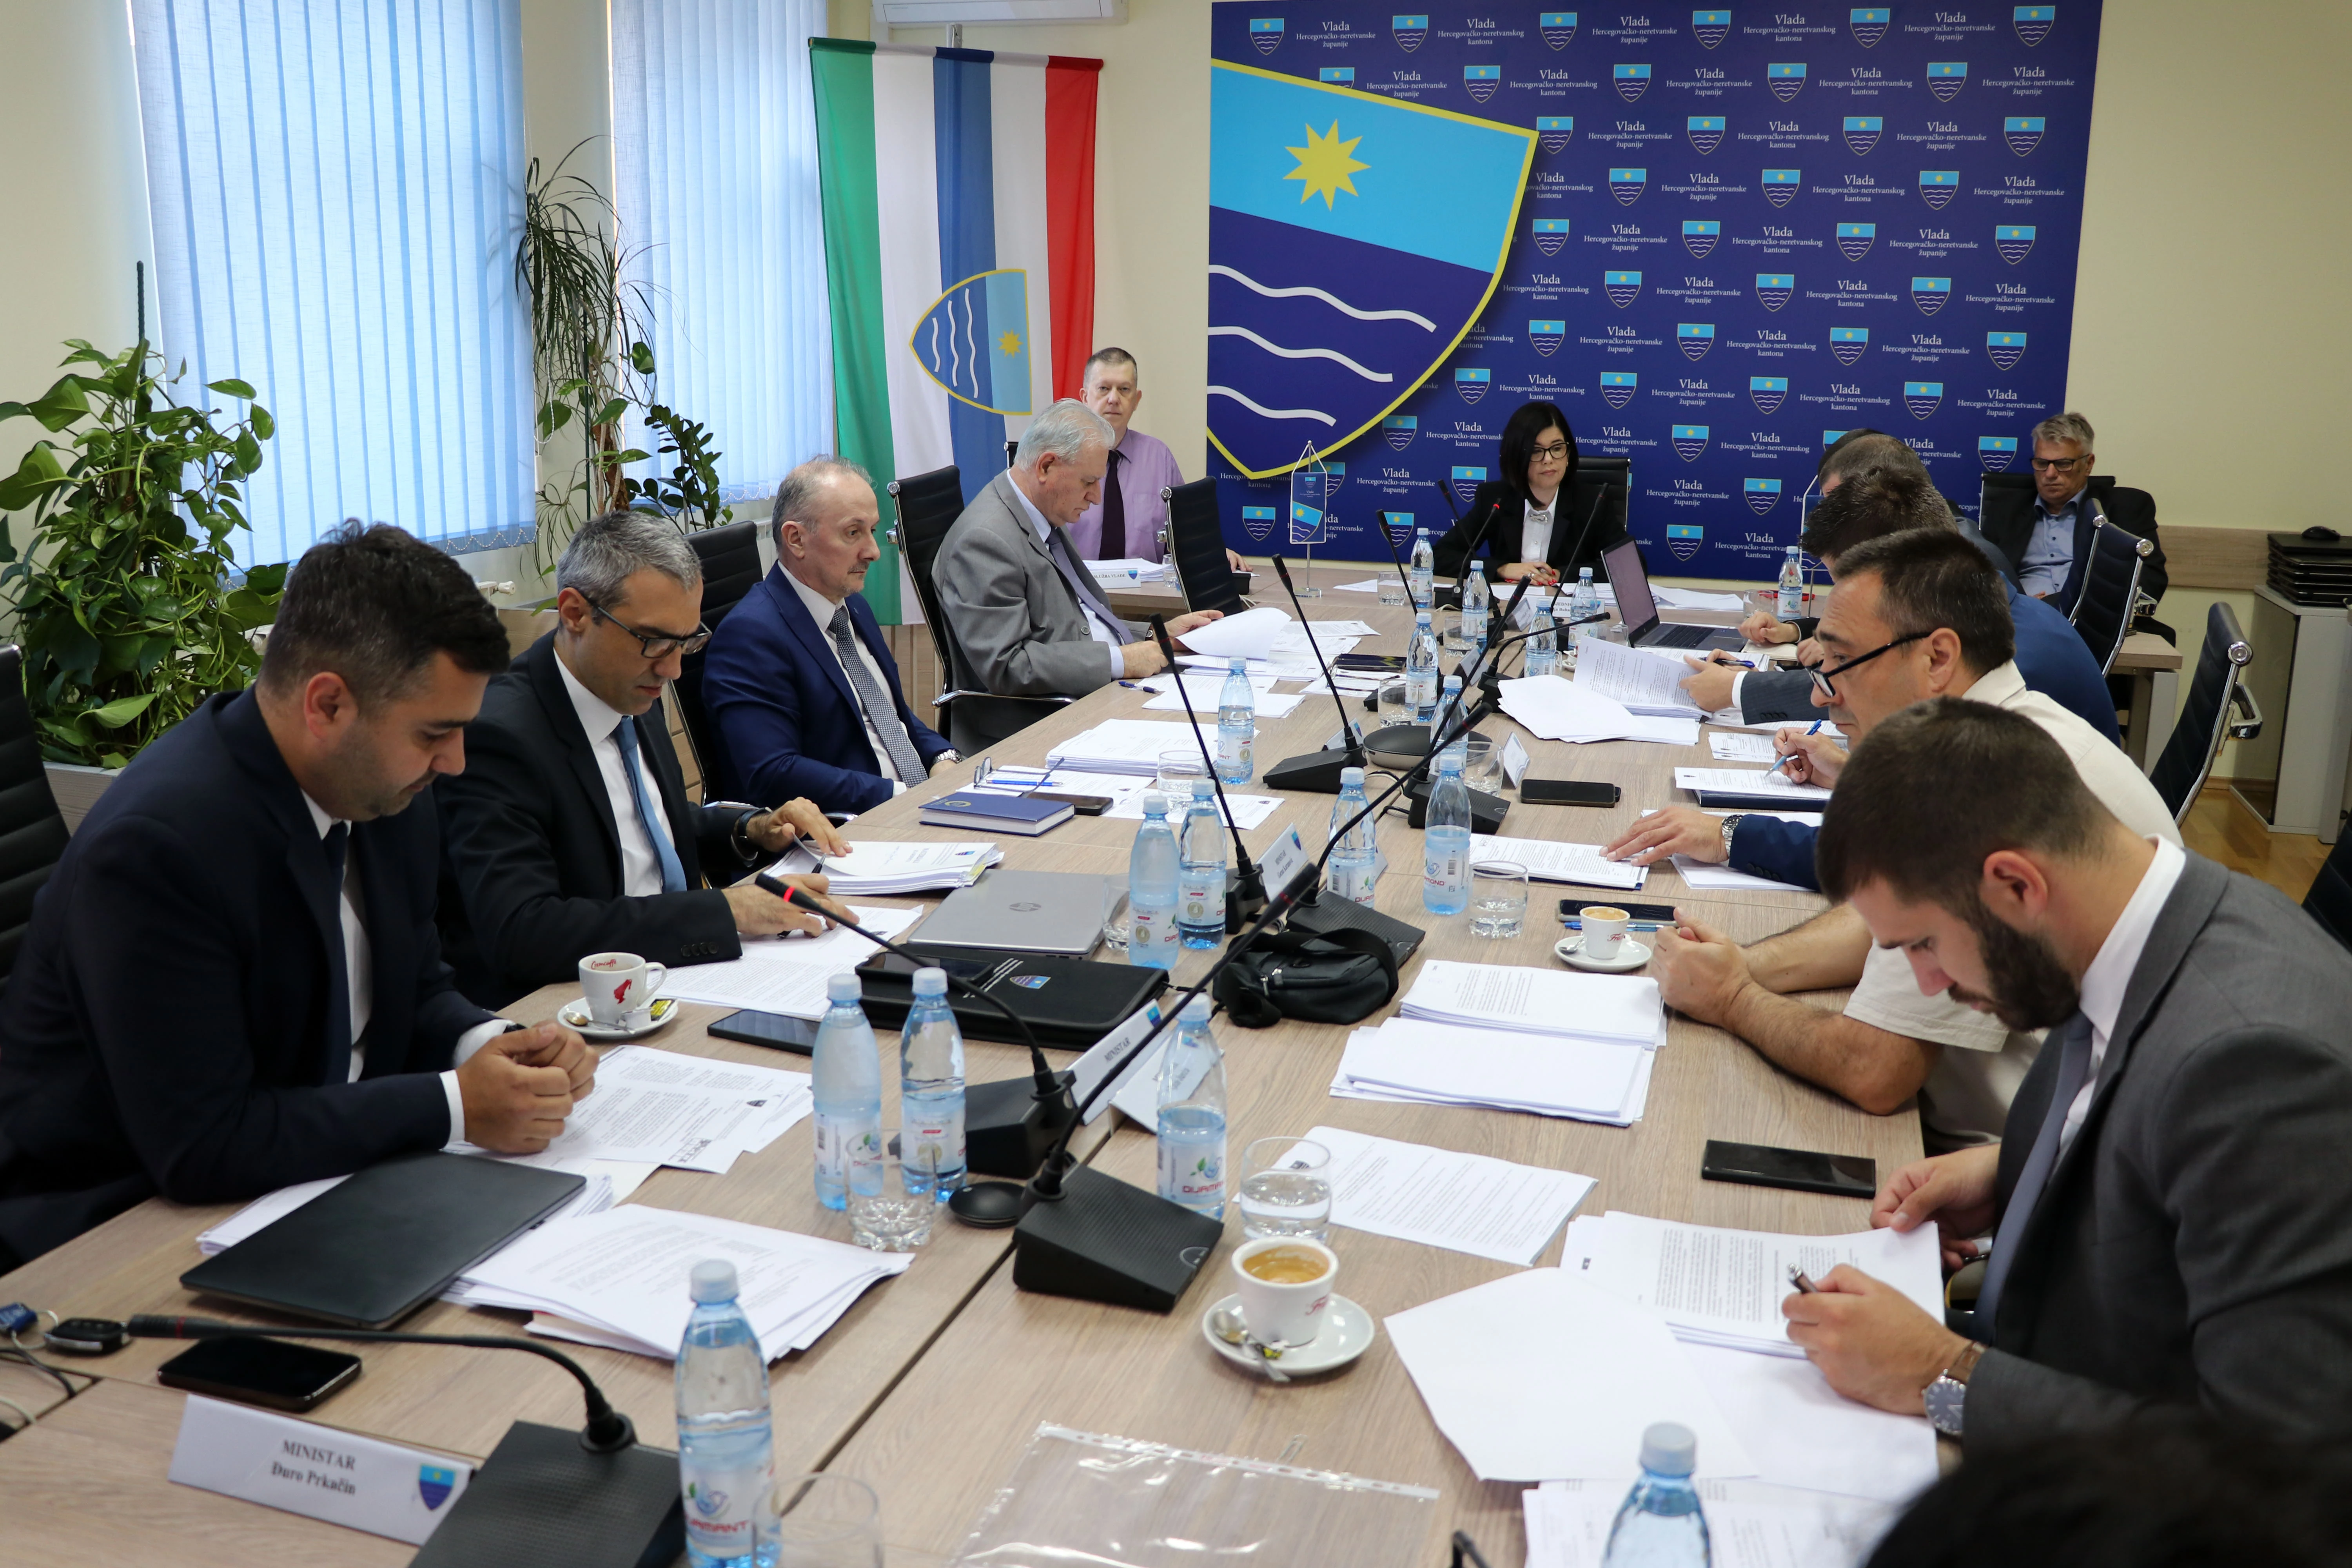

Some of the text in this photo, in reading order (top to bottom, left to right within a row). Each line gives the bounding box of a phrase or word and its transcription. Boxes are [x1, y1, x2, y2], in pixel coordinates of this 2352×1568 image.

[1620, 16, 1650, 26] Vlada
[1775, 14, 1806, 25] Vlada
[1935, 12, 1966, 23] Vlada
[1321, 21, 1350, 31] Vlada
[1466, 18, 1496, 29] Vlada
[1904, 24, 1996, 33] Hercegovačko-neretvanske
[1437, 29, 1525, 39] Hercegovačko-neretvanskog
[1592, 27, 1678, 36] Hercegovačko-neretvanske
[1743, 25, 1836, 35] Hercegovačko-neretvanskog
[1296, 31, 1376, 41] Hercegovačko-neretvanske
[1620, 36, 1648, 45] županije
[1934, 34, 1964, 42] županije
[1323, 41, 1348, 49] županije
[1392, 70, 1421, 81] Vlada
[1539, 69, 1569, 80] Vlada
[1694, 68, 1725, 79] Vlada
[1851, 67, 1882, 78] Vlada
[2013, 66, 2045, 77] Vlada
[1366, 82, 1448, 91] Hercegovačko-neretvanske
[1510, 80, 1598, 89] Hercegovačko-neretvanskog
[1666, 80, 1753, 89] Hercegovačko-neretvanske
[1818, 79, 1913, 89] Hercegovačko-neretvanskog
[1982, 78, 2075, 88] Hercegovačko-neretvanske
[1694, 89, 1723, 97] županije
[2012, 88, 2043, 96] županije
[1615, 121, 1646, 131] Vlada
[1768, 121, 1799, 131] Vlada
[1926, 121, 1958, 132] Vlada
[1588, 132, 1673, 141] Hercegovačko-neretvanske
[1737, 132, 1830, 142] Hercegovačko-neretvanskog
[1896, 133, 1987, 143] Hercegovačko-neretvanske
[1616, 141, 1644, 149] županije
[1926, 142, 1956, 151] županije
[1536, 172, 1565, 183] Vlada
[1689, 173, 1720, 183] Vlada
[1844, 174, 1875, 185] Vlada
[2004, 176, 2036, 187] Vlada
[1661, 185, 1747, 193] Hercegovačko-neretvanske
[1812, 186, 1906, 196] Hercegovačko-neretvanskog
[1973, 188, 2065, 197] Hercegovačko-neretvanske
[1689, 193, 1717, 201] županije
[2003, 197, 2033, 206] županije
[1611, 224, 1641, 234] Vlada
[1762, 226, 1793, 237] Vlada
[1583, 235, 1668, 244] Hercegovačko-neretvanske
[1919, 229, 1950, 240] Vlada
[1732, 237, 1823, 247] Hercegovačko-neretvanskog
[1889, 240, 1979, 249] Hercegovačko-neretvanske
[1611, 244, 1639, 252] županije
[1918, 249, 1947, 258] županije
[1531, 274, 1561, 284] Vlada
[1684, 276, 1714, 287] Vlada
[1503, 285, 1590, 295] Hercegovačko-neretvanskog
[1837, 280, 1868, 290] Vlada
[1995, 283, 2027, 294] Vlada
[1656, 287, 1741, 296] Hercegovačko-neretvanske
[1806, 291, 1898, 301] Hercegovačko-neretvanskog
[1684, 296, 1712, 305] županije
[1965, 294, 2056, 304] Hercegovačko-neretvanske
[1994, 304, 2024, 312] županije
[1606, 326, 1636, 337] Vlada
[1757, 330, 1787, 341] Vlada
[1579, 336, 1663, 345] Hercegovačko-neretvanske
[1911, 334, 1942, 345] Vlada
[1607, 345, 1634, 354] županije
[1726, 340, 1817, 351] Hercegovačko-neretvanskog
[1882, 345, 1970, 354] Hercegovačko-neretvanske
[1911, 354, 1940, 363] županije
[1528, 374, 1557, 385] Vlada
[1679, 379, 1709, 389] Vlada
[1499, 384, 1585, 395] Hercegovačko-neretvanskog
[1651, 389, 1736, 398] Hercegovačko-neretvanske
[1830, 383, 1861, 394] Vlada
[1987, 388, 2018, 400] Vlada
[1679, 398, 1707, 407] županije
[1799, 394, 1891, 406] Hercegovačko-neretvanskog
[1957, 399, 2046, 409] Hercegovačko-neretvanske
[1986, 409, 2015, 417] županije
[1454, 421, 1483, 432] Vlada
[1602, 426, 1632, 437] Vlada
[1575, 436, 1658, 446] Hercegovačko-neretvanske
[1750, 432, 1781, 443] Vlada
[1602, 445, 1630, 454] županije
[1720, 442, 1810, 454] Hercegovačko-neretvanskog
[1382, 468, 1410, 478] Vlada
[1356, 477, 1436, 486] Hercegovačko-neretvanske
[1673, 479, 1703, 490] Vlada
[1383, 486, 1408, 495] županije
[1646, 489, 1730, 499] Hercegovačko-neretvanske
[1673, 498, 1701, 507] županije
[1744, 532, 1774, 543] Vlada
[1104, 1036, 1131, 1063] MINISTAR
[282, 1440, 356, 1471] MINISTAR
[306, 1469, 356, 1496] Prkačin
